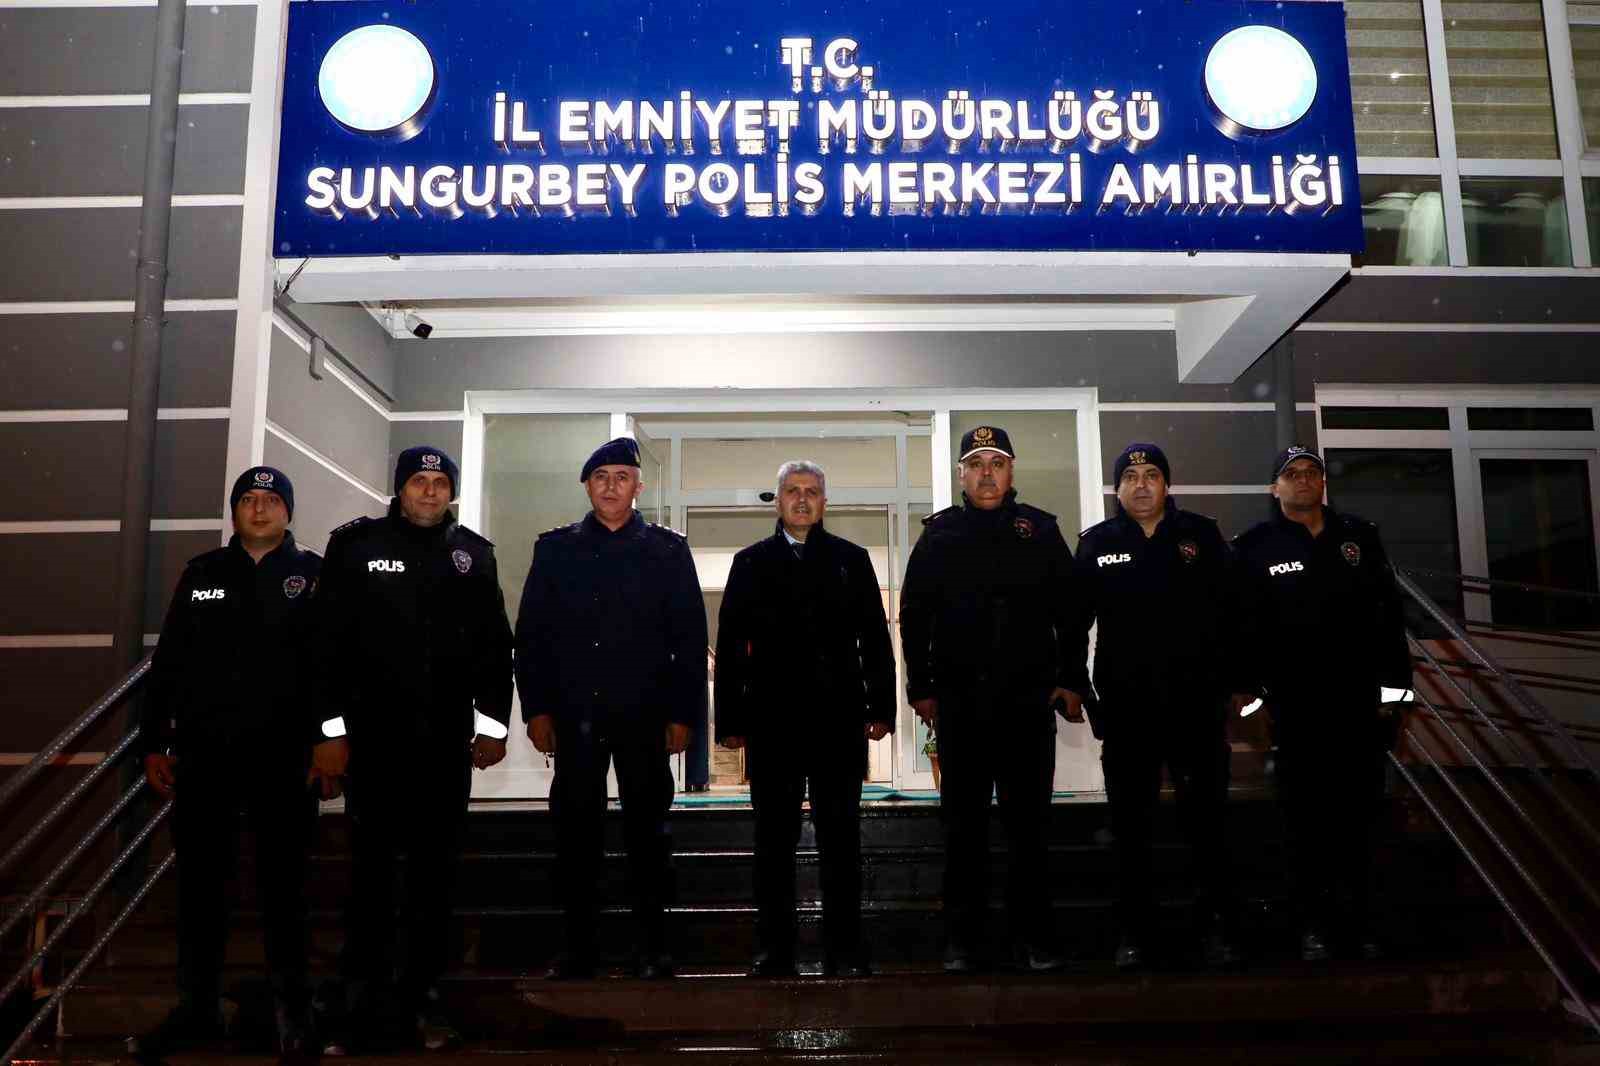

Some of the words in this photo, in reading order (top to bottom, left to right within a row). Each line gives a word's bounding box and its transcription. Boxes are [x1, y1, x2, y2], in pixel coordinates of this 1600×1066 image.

[781, 37, 874, 78] T.C.
[493, 91, 541, 142] İL
[560, 90, 800, 142] EMNİYET
[817, 89, 1161, 142] MÜDÜRLÜĞÜ
[305, 163, 648, 209] SUNGURBEY
[664, 152, 825, 206] POLİS
[842, 152, 1082, 206] MERKEZİ
[1103, 153, 1343, 206] AMİRLİĞİ
[367, 559, 405, 572] POLIS
[1097, 553, 1131, 567] POLIS
[1268, 560, 1304, 576] POLIS
[191, 588, 225, 601] POLIS
